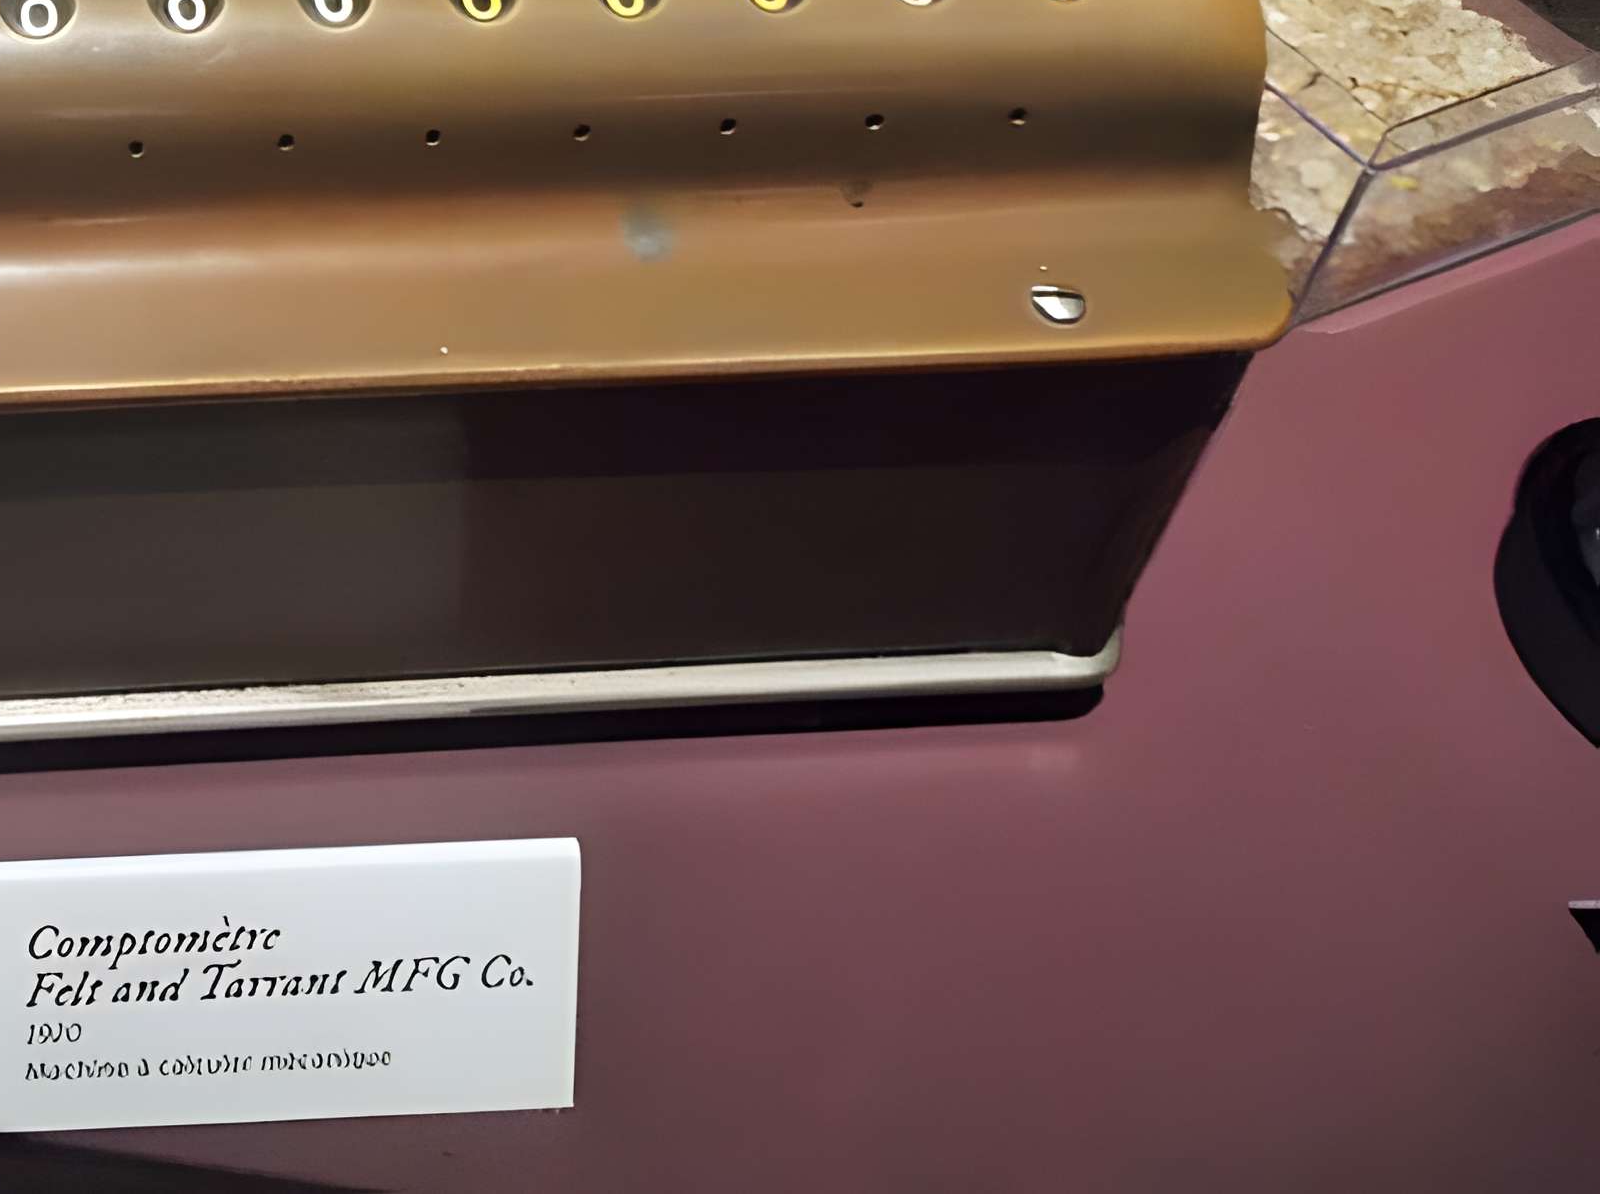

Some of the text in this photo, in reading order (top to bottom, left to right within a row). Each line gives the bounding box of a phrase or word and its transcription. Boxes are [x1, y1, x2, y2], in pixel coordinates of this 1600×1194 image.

[111, 968, 190, 1003] and
[200, 959, 348, 1000] Tarrant
[353, 955, 471, 994] MFG
[481, 954, 534, 988] Co.
